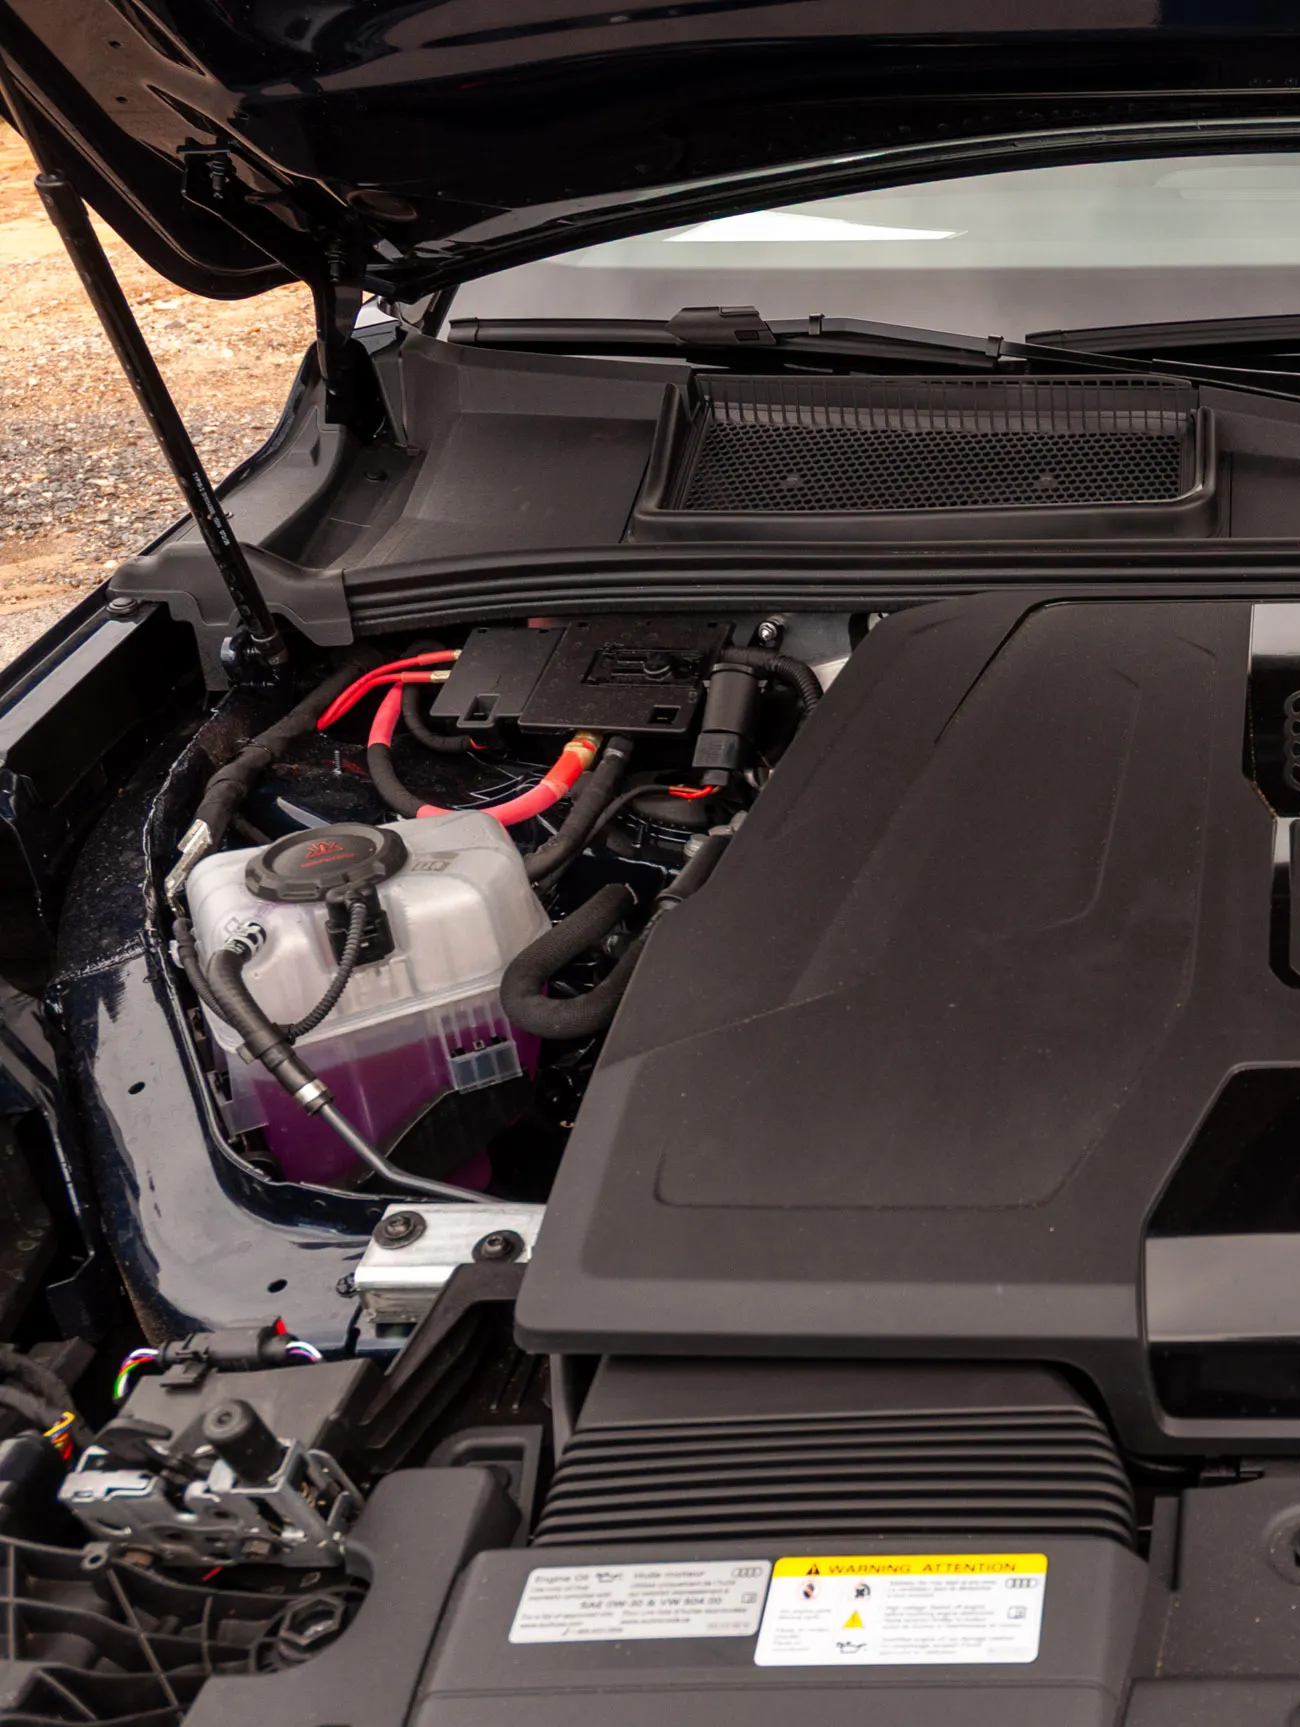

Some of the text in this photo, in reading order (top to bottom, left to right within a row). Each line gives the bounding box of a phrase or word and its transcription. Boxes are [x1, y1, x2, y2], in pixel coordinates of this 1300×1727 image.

[633, 1570, 707, 1579] Huile moteur
[828, 1563, 1017, 1575] WARNING ATTENTION
[535, 1573, 589, 1584] Engine Oil
